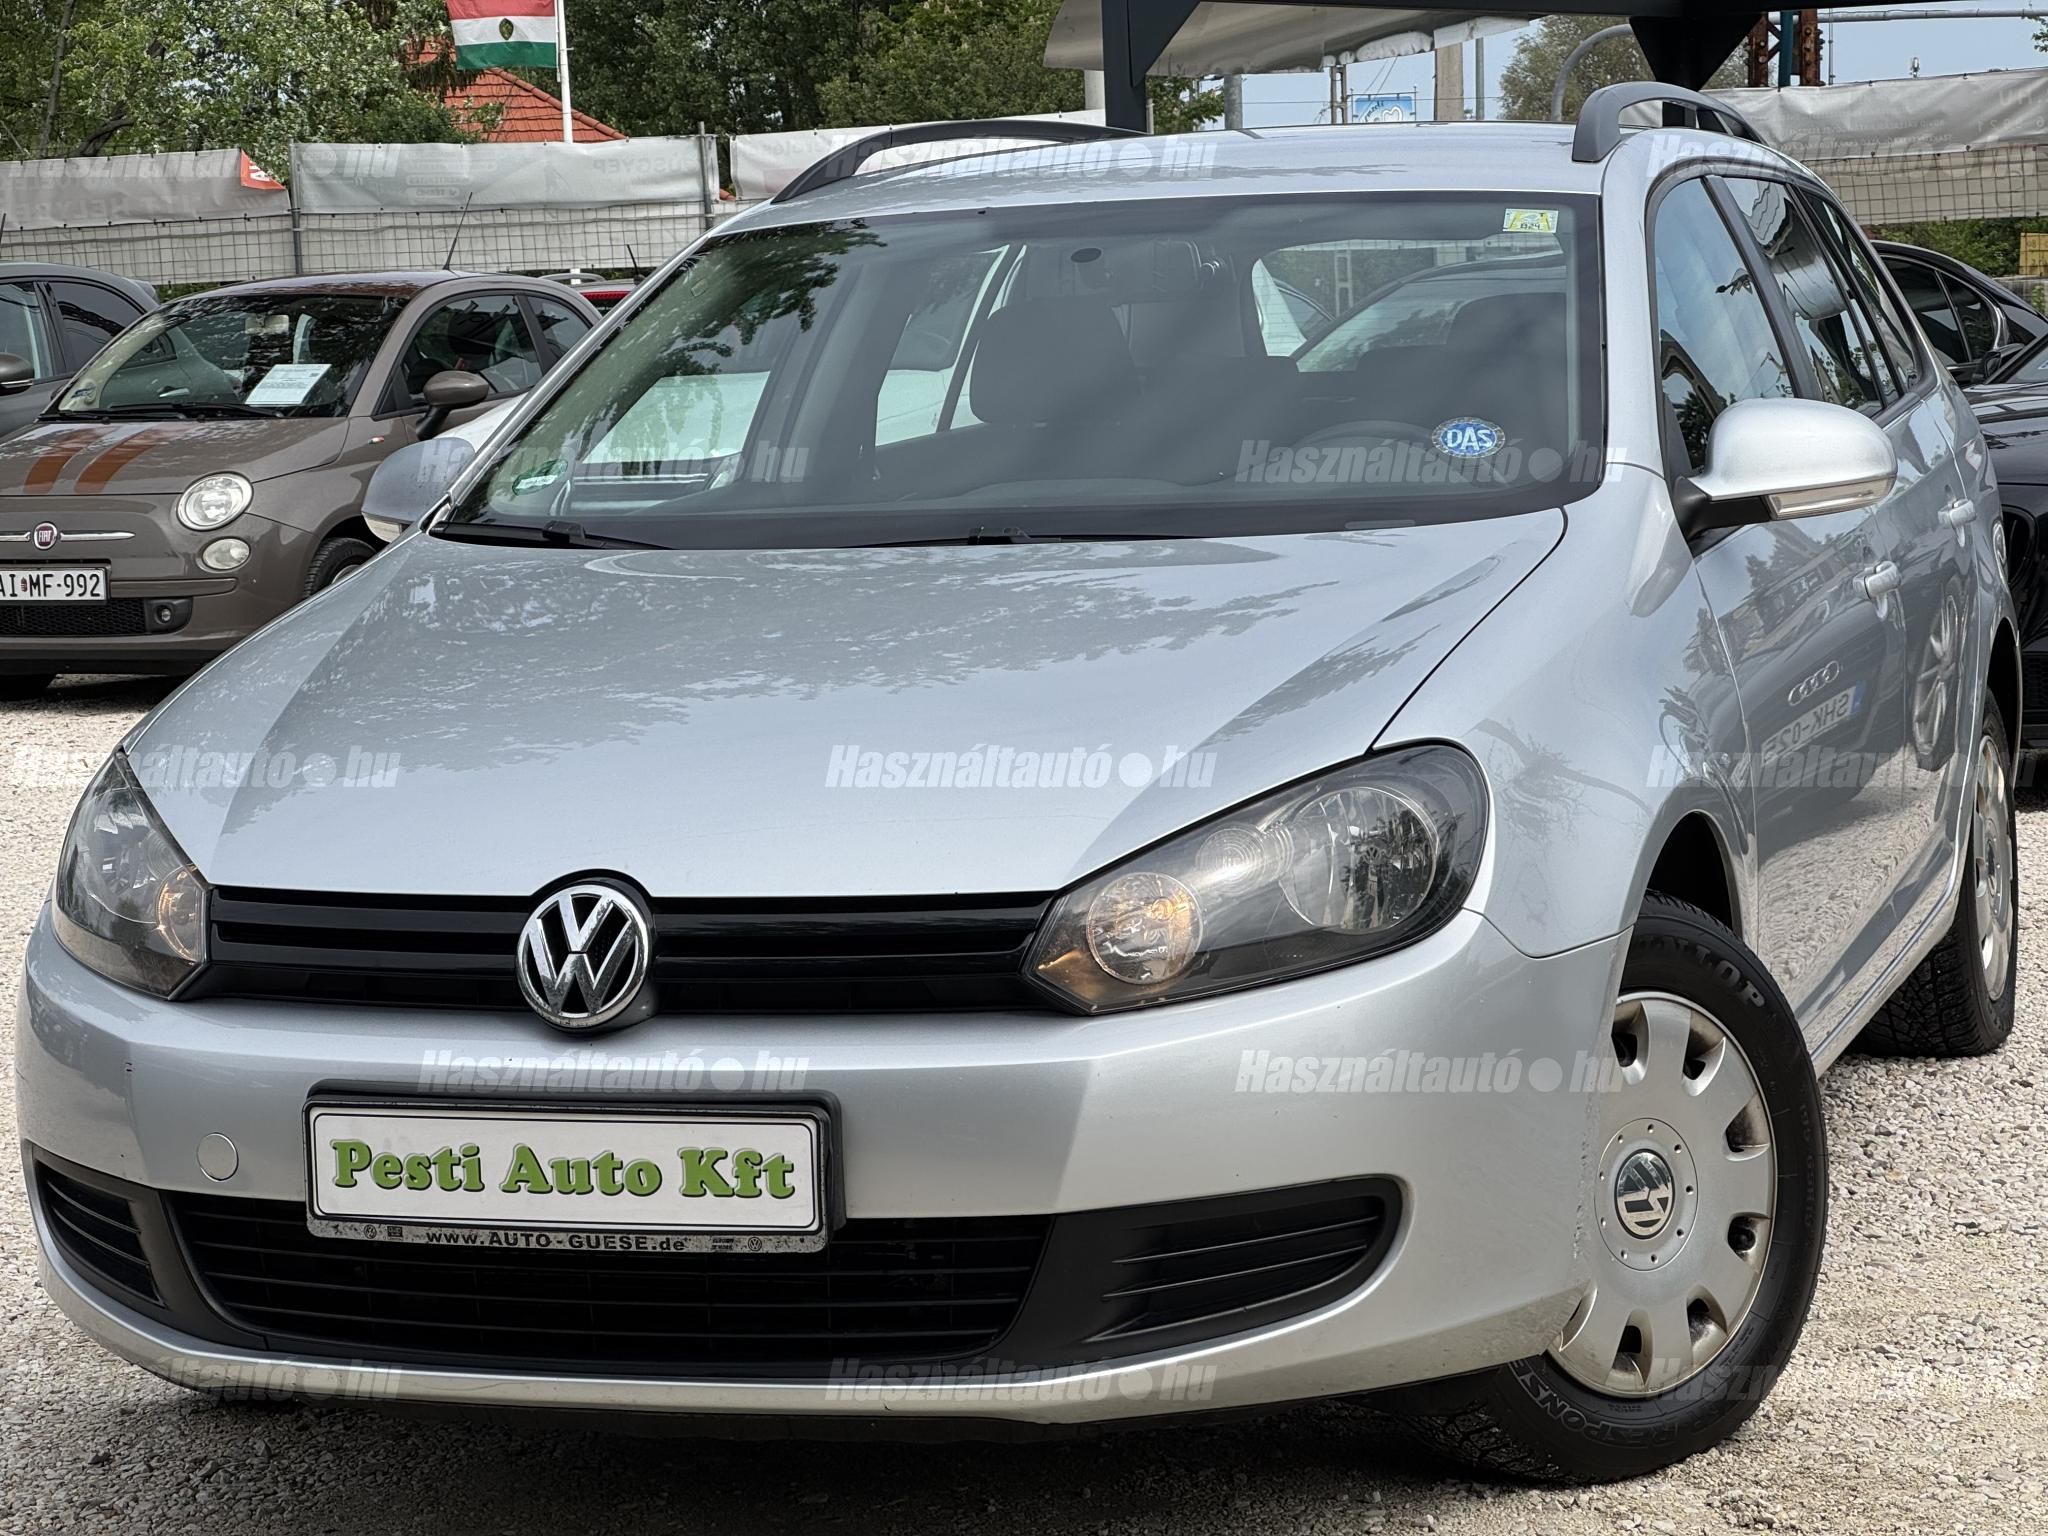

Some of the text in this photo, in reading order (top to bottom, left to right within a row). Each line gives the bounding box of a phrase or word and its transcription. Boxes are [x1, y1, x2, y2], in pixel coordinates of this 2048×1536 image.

[1446, 426, 1493, 451] DAS
[38, 530, 53, 543] FIAT
[28, 573, 101, 598] MF-992
[330, 1138, 796, 1198] Pesti Auto Kft
